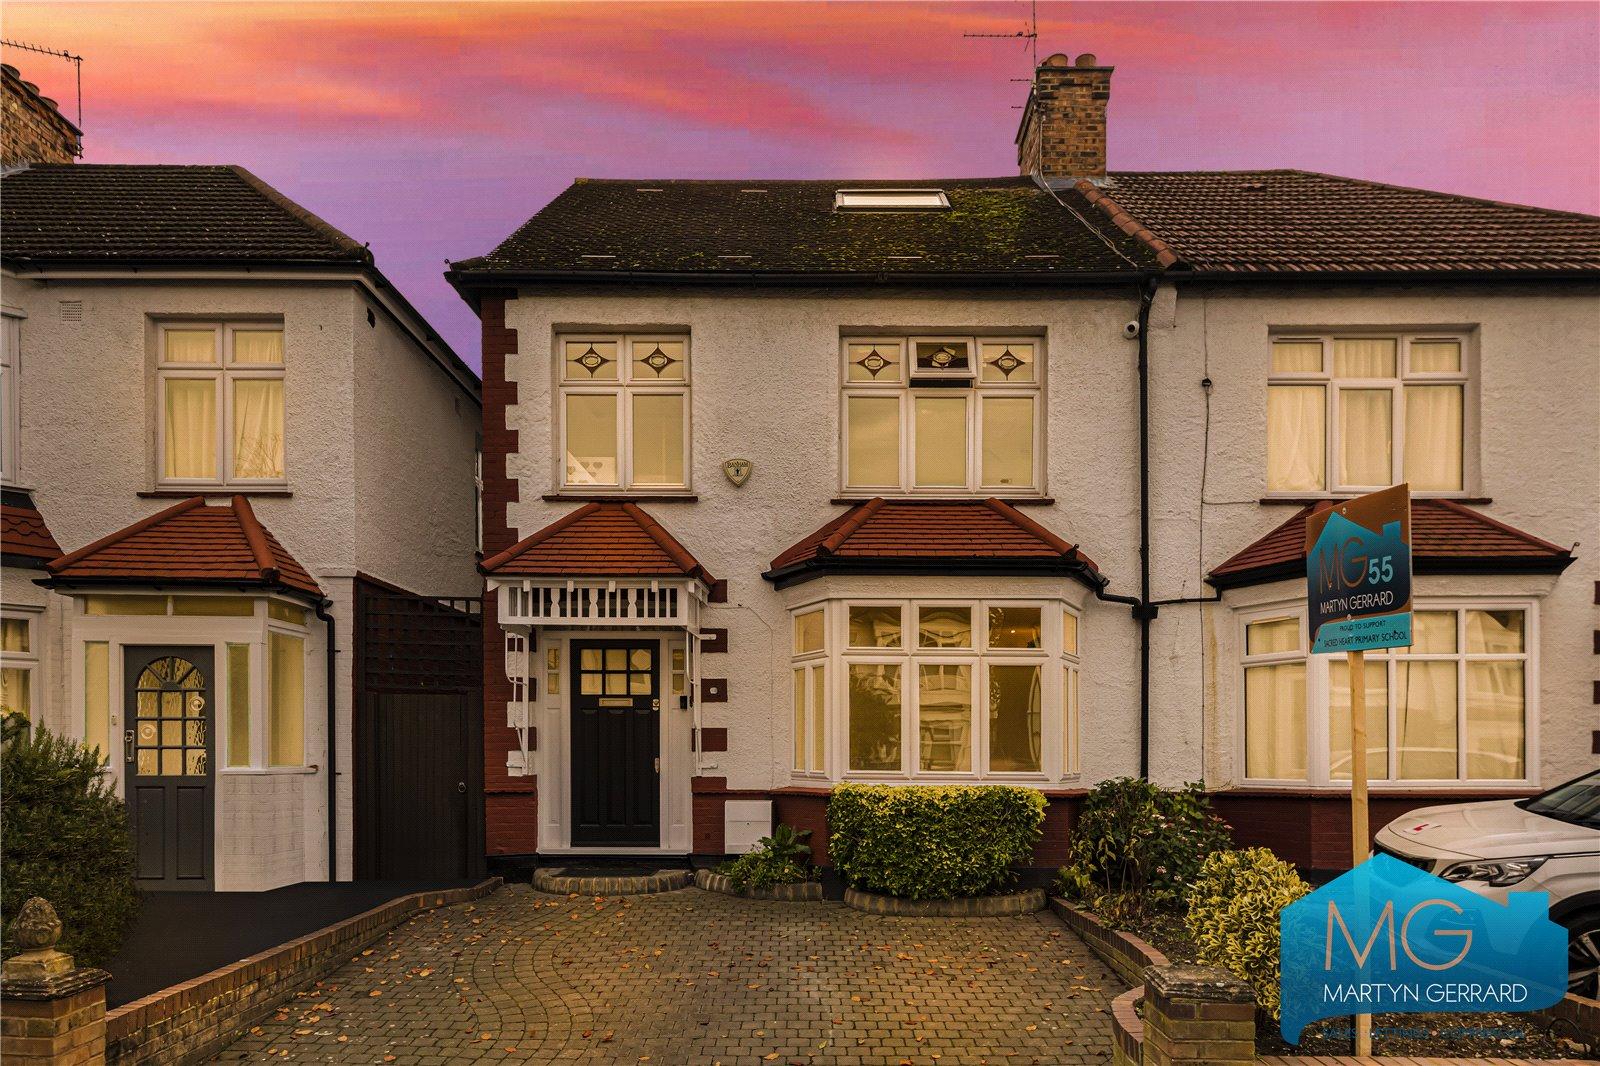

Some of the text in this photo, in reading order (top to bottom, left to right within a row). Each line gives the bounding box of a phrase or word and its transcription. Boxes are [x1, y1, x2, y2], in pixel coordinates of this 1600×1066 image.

[1319, 536, 1368, 594] MG
[1368, 555, 1394, 585] 55
[1320, 590, 1394, 614] MARTYN GERRARD
[1355, 633, 1380, 644] PRIMARY
[1381, 630, 1407, 642] SCHOOL
